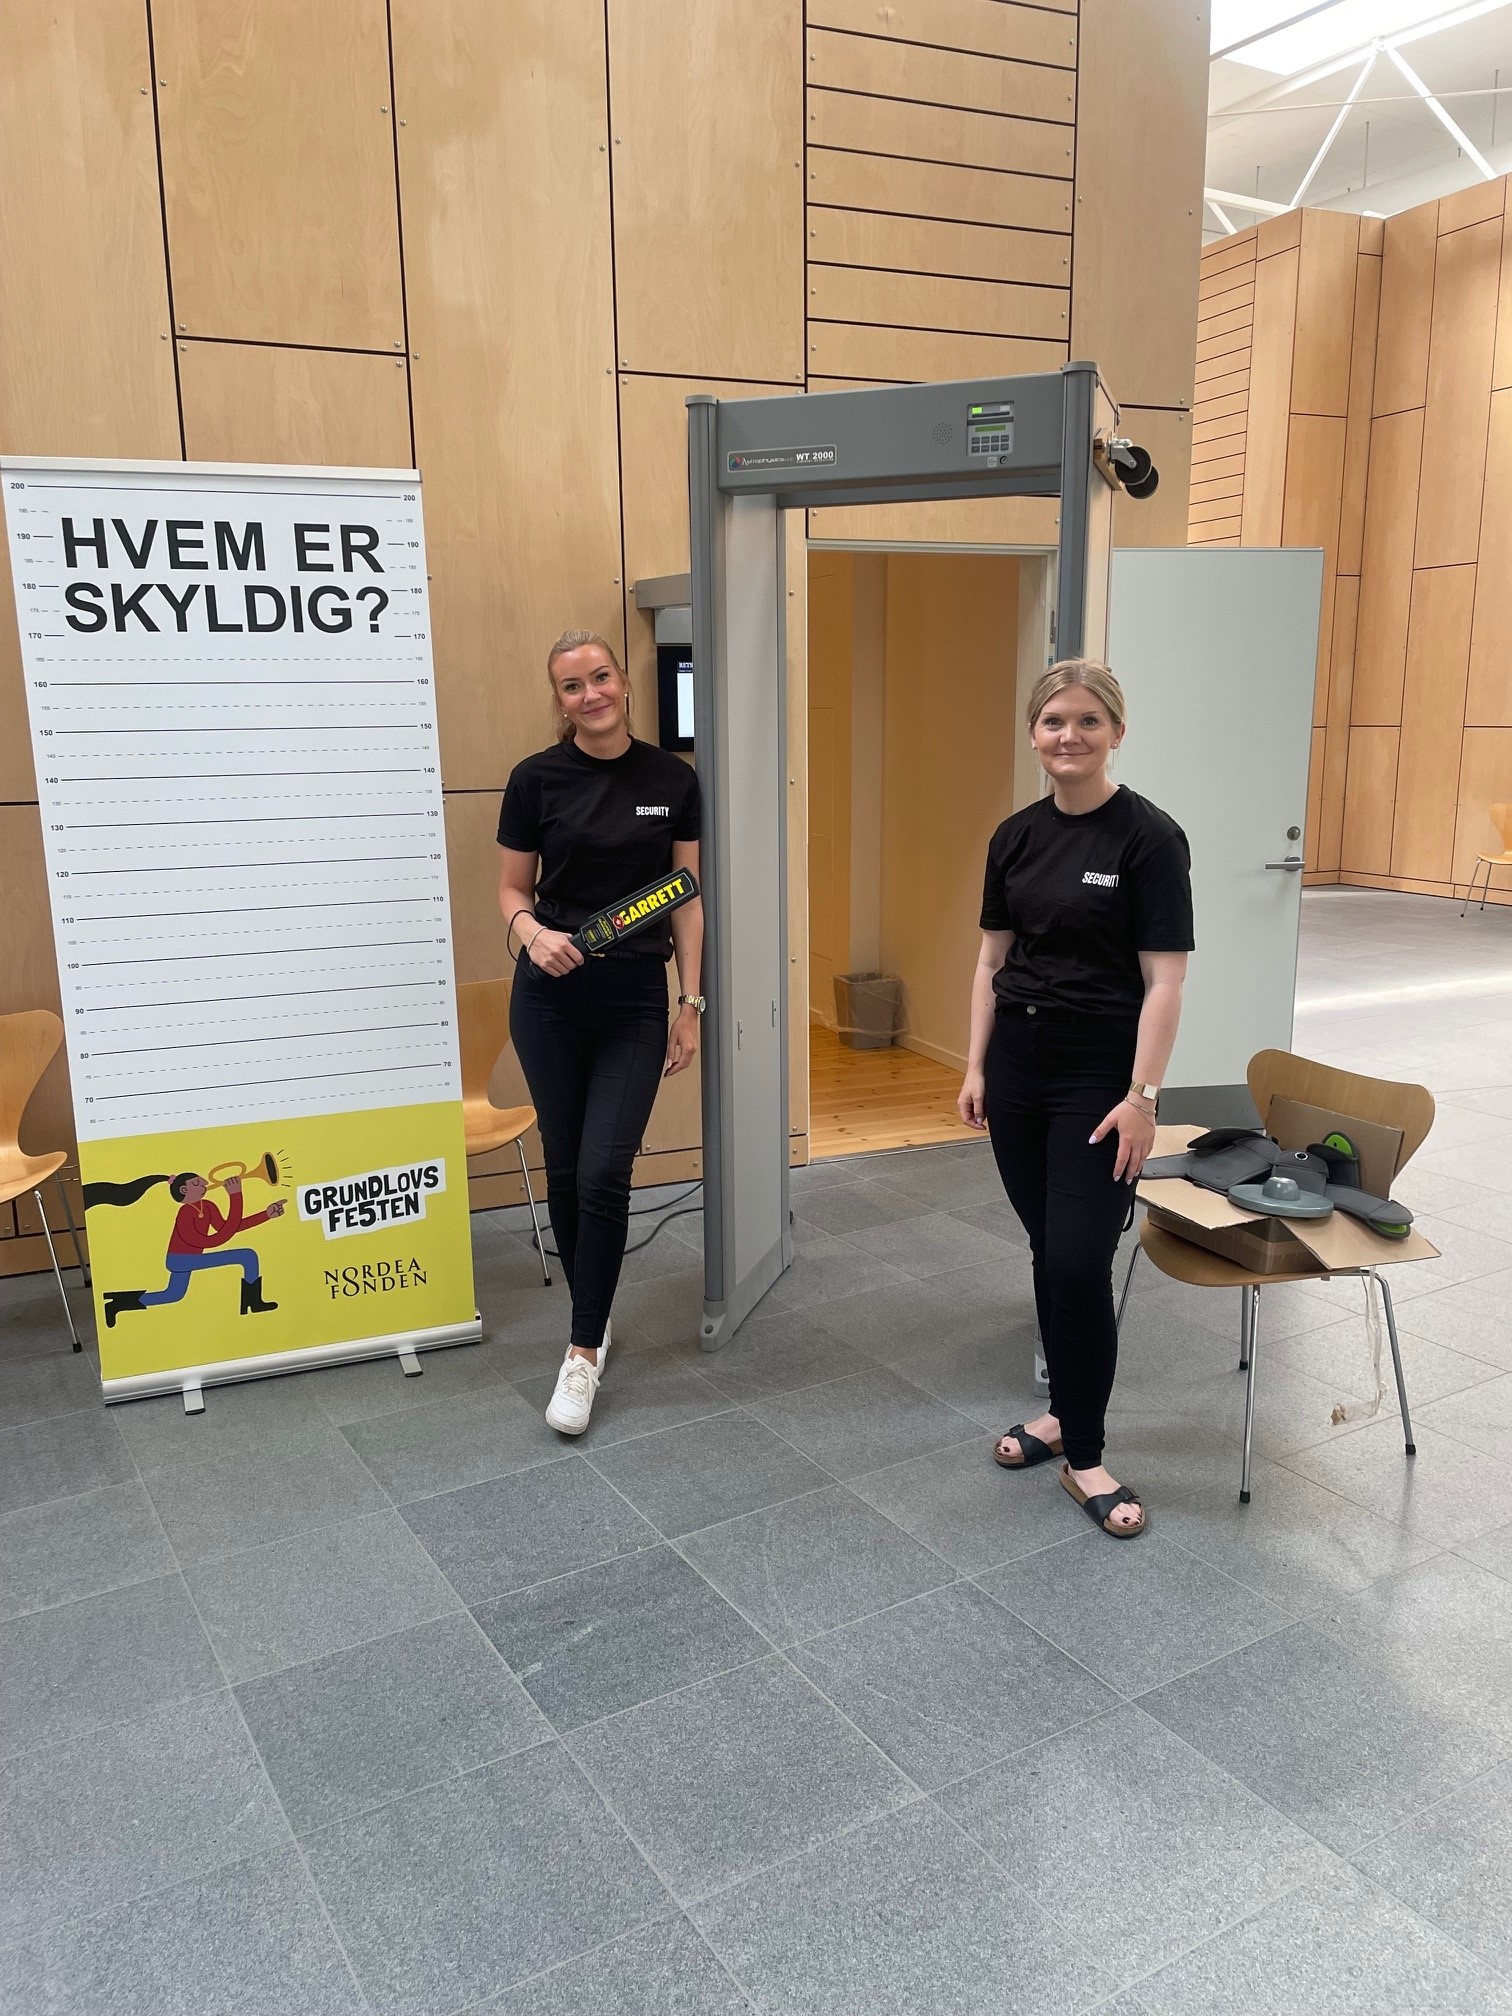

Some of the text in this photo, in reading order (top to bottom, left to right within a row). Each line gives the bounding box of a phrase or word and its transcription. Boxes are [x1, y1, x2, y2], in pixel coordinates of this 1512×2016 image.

[796, 453, 810, 461] WT
[812, 451, 834, 460] 2000
[10, 482, 25, 490] 200
[61, 517, 386, 573] HVEM ER
[64, 582, 390, 634] SKYLDIG?
[635, 805, 670, 818] SECURITY
[619, 878, 685, 926] GARRETT
[304, 1165, 439, 1215] GRUNDLOVS
[323, 1257, 421, 1285] NORDEA
[331, 1271, 428, 1300] FONDEN
